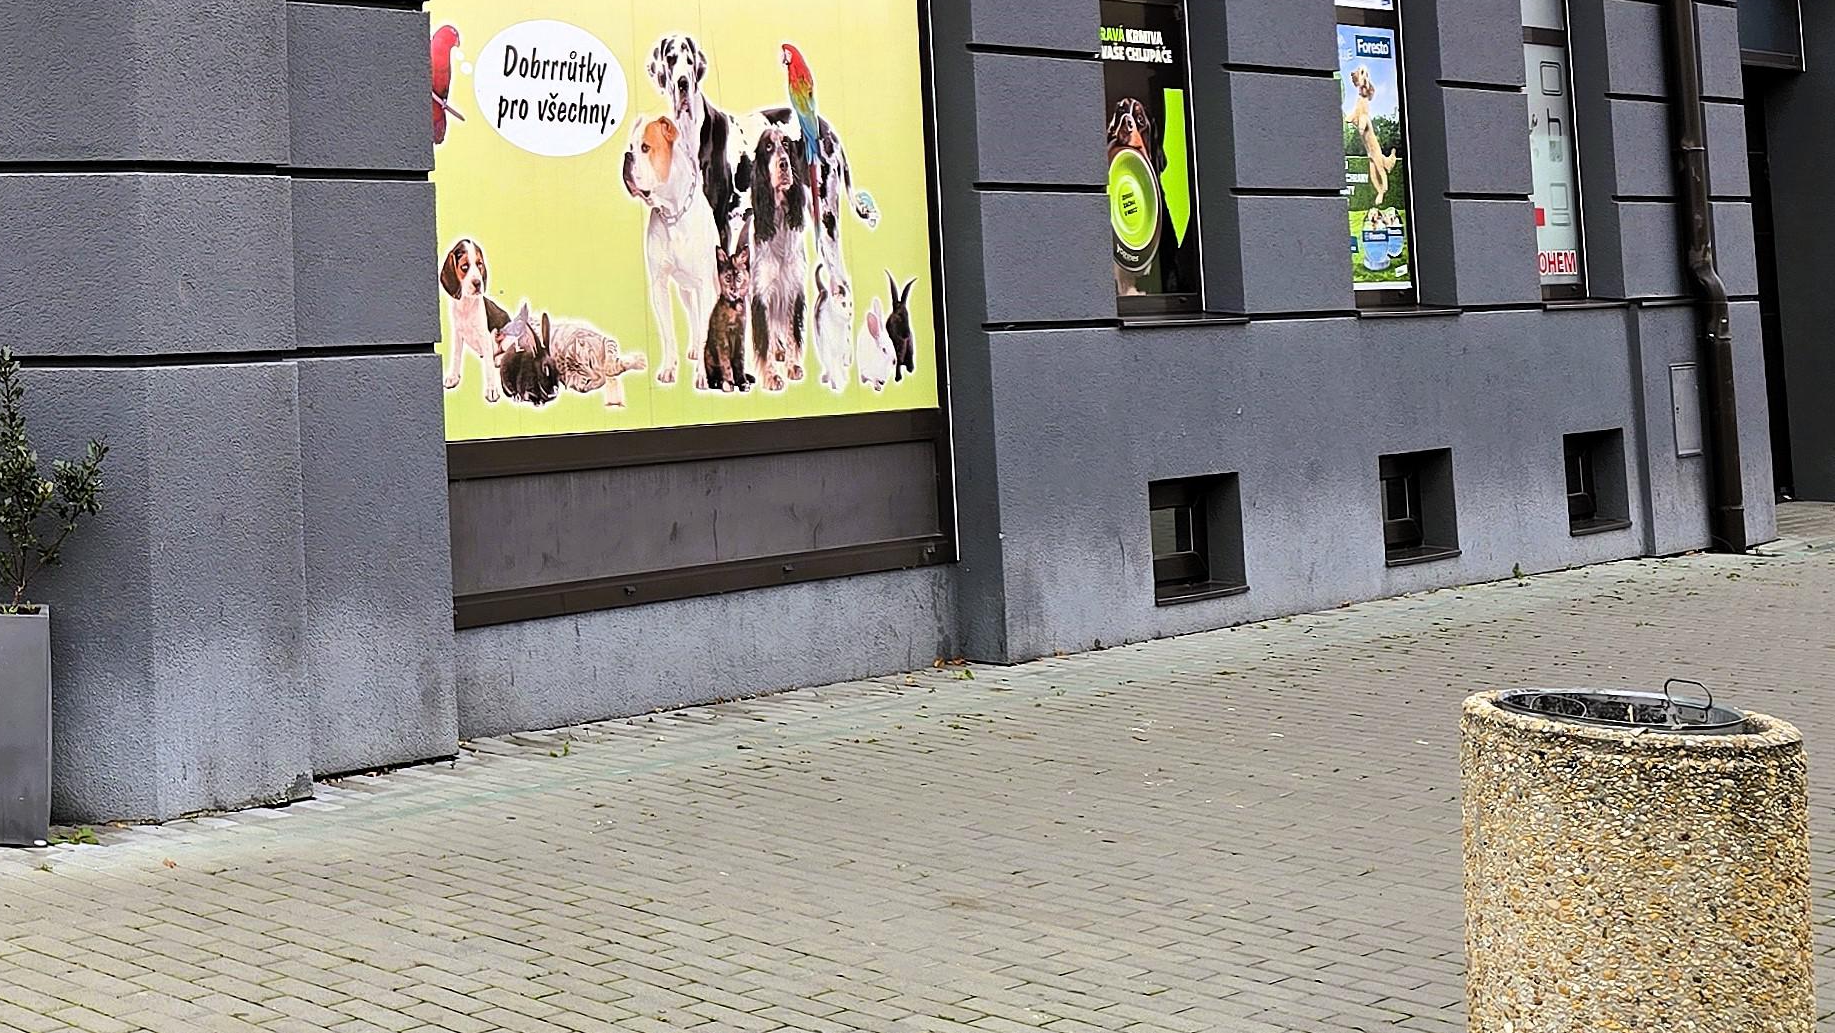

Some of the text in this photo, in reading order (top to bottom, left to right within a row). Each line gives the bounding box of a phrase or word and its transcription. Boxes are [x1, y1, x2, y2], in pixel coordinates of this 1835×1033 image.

[1125, 46, 1173, 64] CHLUPÁČE
[1356, 38, 1389, 55] Foresto
[502, 42, 609, 94] Dobrrrůtky
[496, 91, 617, 132] pro všechny.
